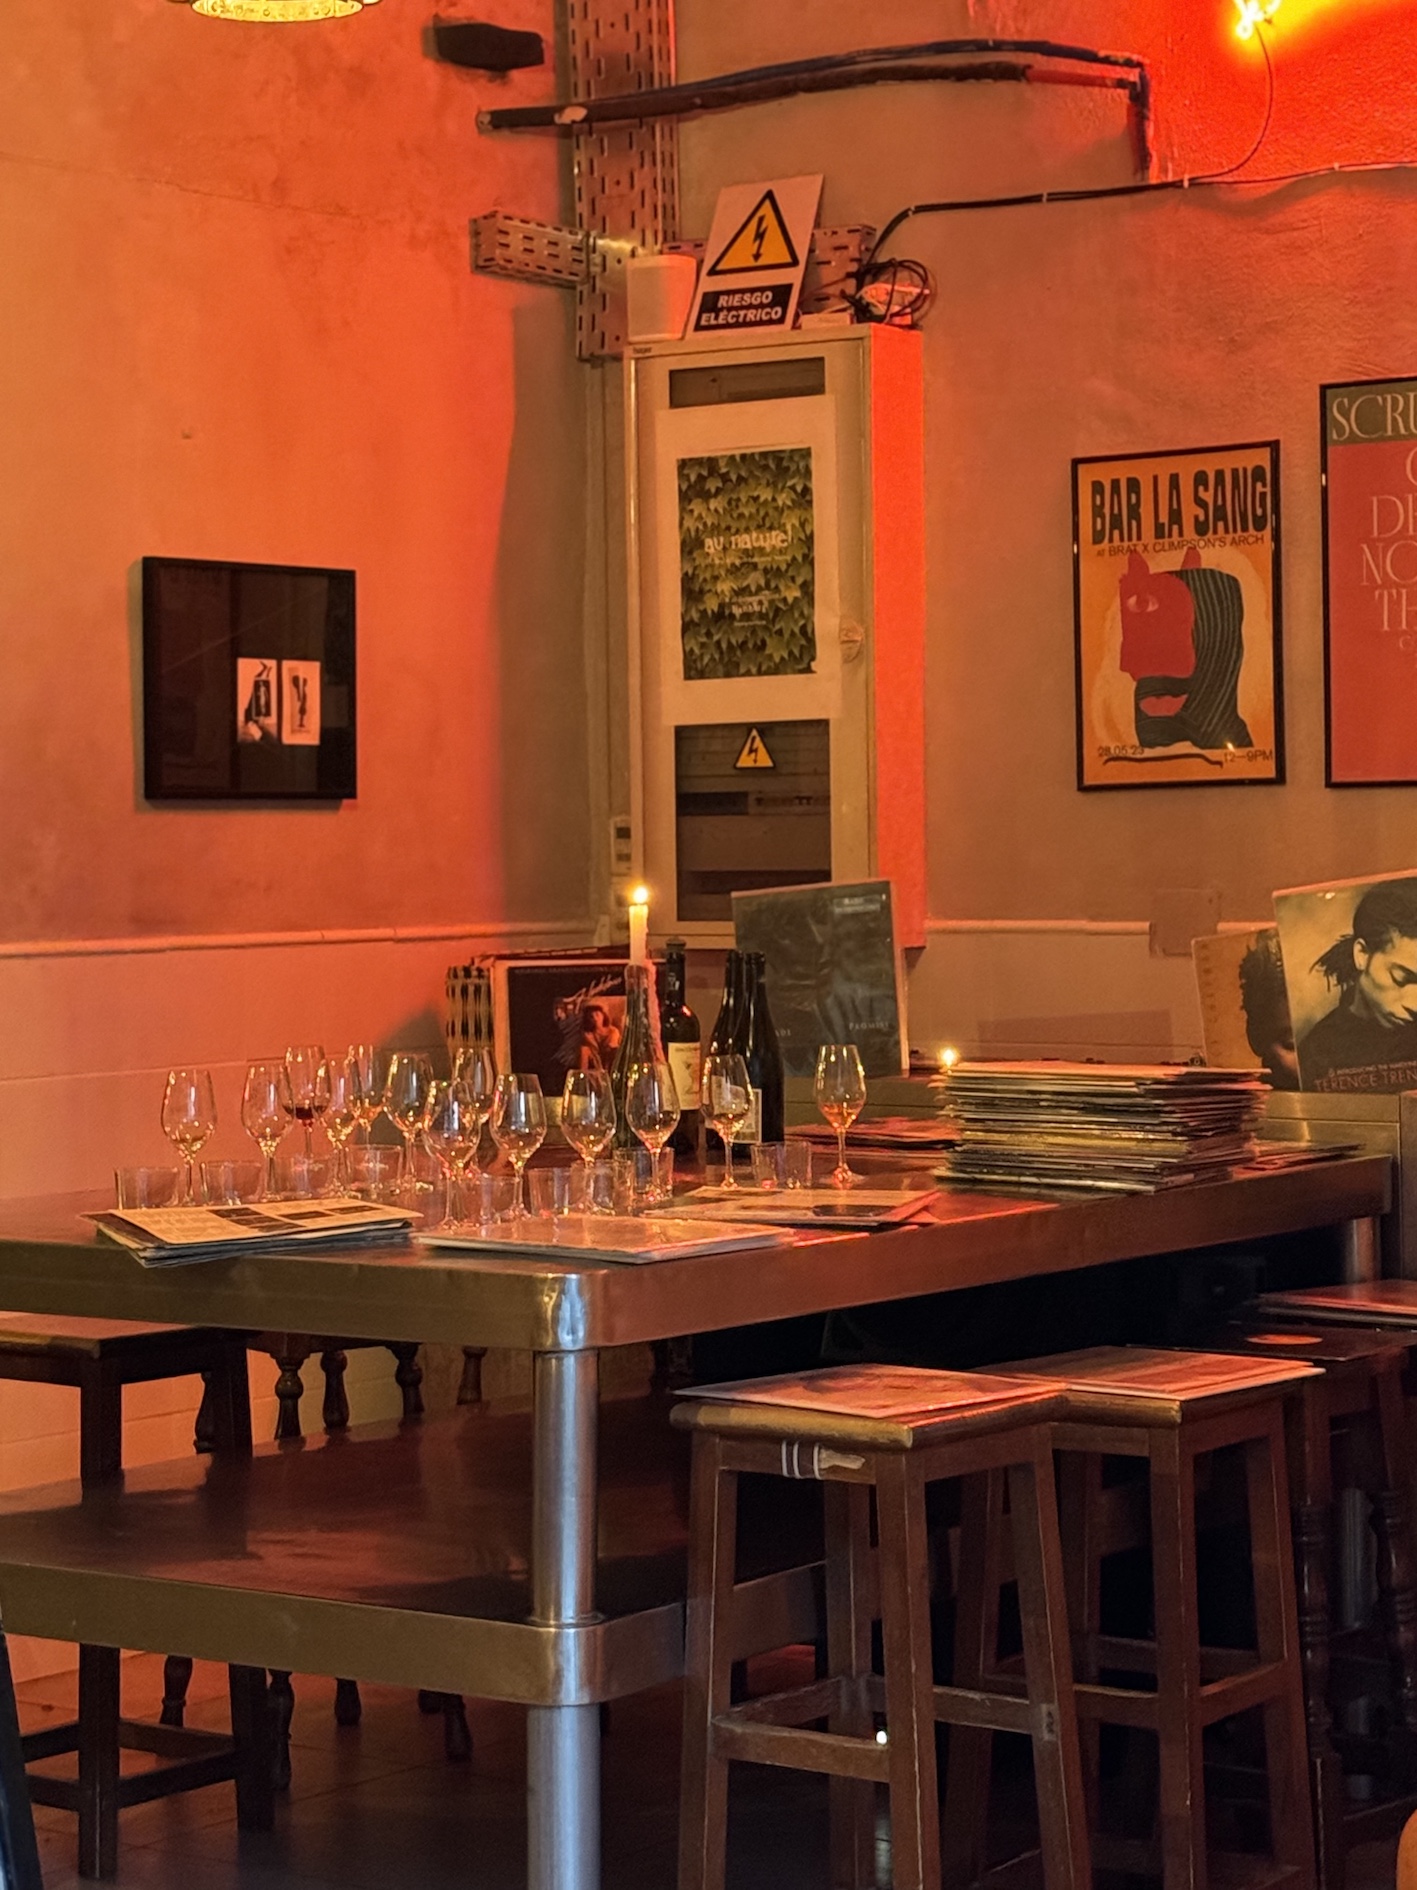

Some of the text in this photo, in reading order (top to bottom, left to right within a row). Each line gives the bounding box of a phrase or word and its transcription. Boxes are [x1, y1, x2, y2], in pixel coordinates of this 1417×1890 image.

[717, 291, 773, 308] RIESGO
[700, 306, 783, 326] ELÉCTRICO
[1091, 465, 1268, 545] BAR LA SANG
[704, 524, 793, 554] au naturel
[1109, 544, 1139, 557] BRAT
[1141, 542, 1150, 554] X
[1153, 536, 1227, 553] CLIMPSON'S
[1230, 534, 1265, 547] ARCH
[1314, 1072, 1379, 1092] TERENCE
